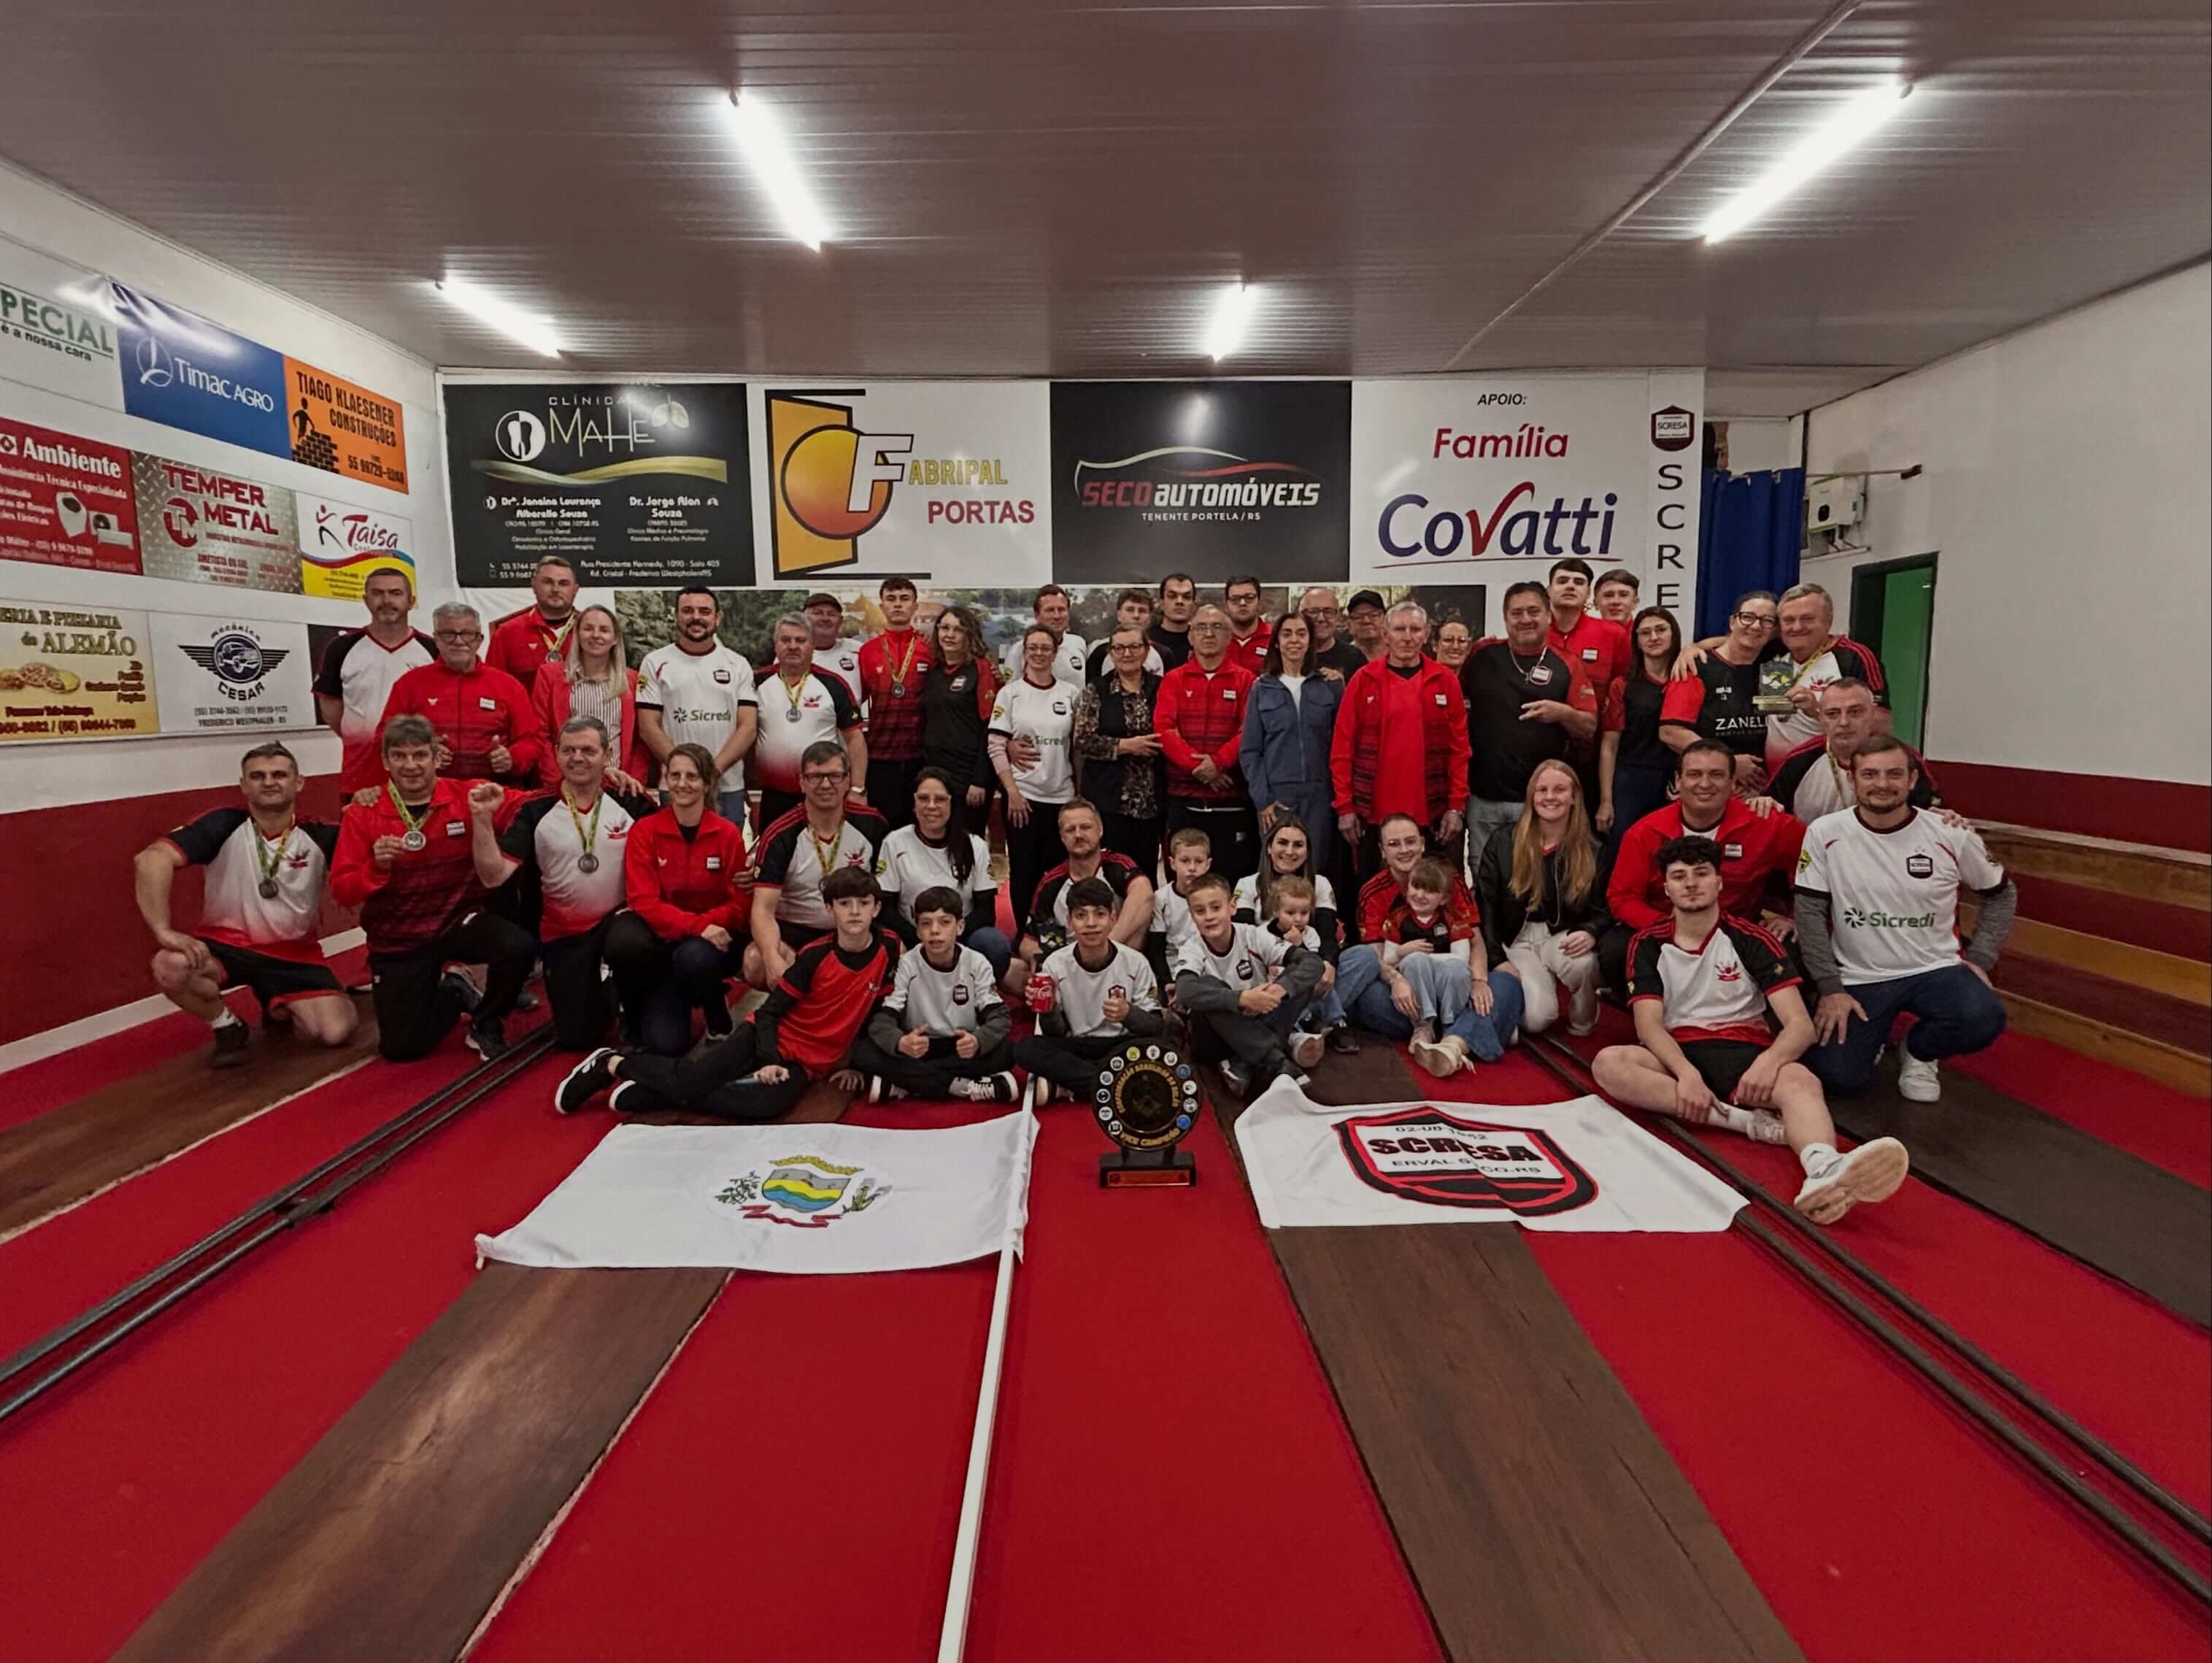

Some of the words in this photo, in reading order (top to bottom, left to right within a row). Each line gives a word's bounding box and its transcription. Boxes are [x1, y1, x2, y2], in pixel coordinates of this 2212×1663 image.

[0, 290, 114, 353] PECIAL
[13, 329, 22, 339] a
[26, 333, 61, 352] nossa
[65, 346, 91, 361] cara
[174, 358, 233, 398] Timac
[234, 385, 274, 412] AGRO
[296, 371, 333, 404] TIAGO
[336, 387, 395, 428] KLAESENER
[1477, 393, 1527, 406] APOIO:
[330, 408, 396, 448] CONSTRUÇÕES
[1433, 423, 1568, 458] Família
[23, 436, 122, 479] Ambiente
[161, 463, 266, 509] TEMPER
[560, 509, 587, 518] Souza
[629, 496, 644, 506] Dr.
[646, 496, 675, 509] Jorge
[651, 508, 683, 518] Souza
[928, 501, 1035, 524] PORTAS
[1142, 512, 1188, 520] TENENTE
[1191, 512, 1238, 520] PORTELA
[1247, 512, 1260, 520] RS
[203, 501, 279, 536] METAL
[342, 514, 398, 549] Taisa
[41, 630, 137, 656] ALEMÃO
[218, 681, 265, 701] CESAR
[1869, 912, 1935, 928] Sicredi
[1367, 1137, 1544, 1162] SCRESA
